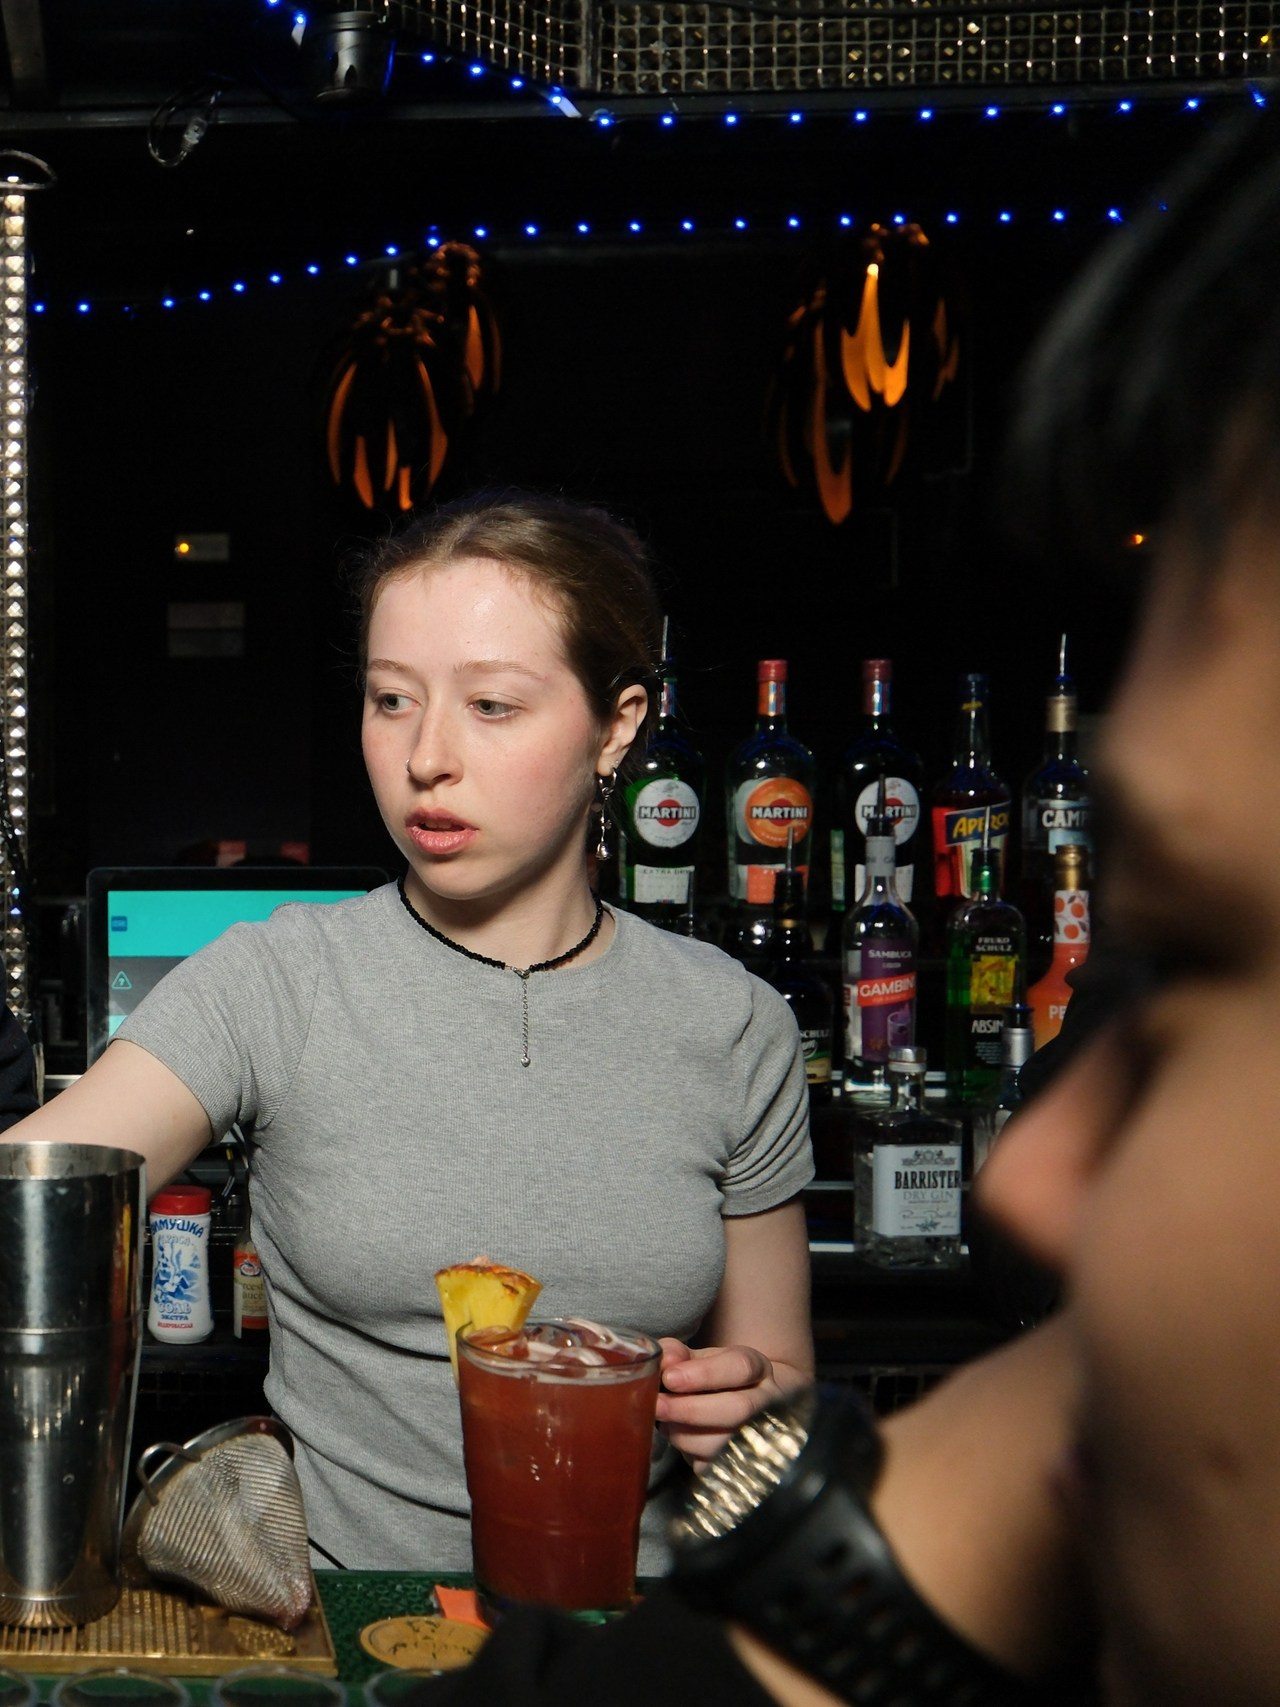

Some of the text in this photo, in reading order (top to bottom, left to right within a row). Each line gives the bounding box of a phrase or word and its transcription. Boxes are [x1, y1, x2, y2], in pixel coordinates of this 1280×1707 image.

[639, 806, 696, 819] MARTINI
[752, 806, 808, 819] MARTINI
[863, 805, 917, 818] MRTINI
[868, 949, 912, 959] SAMBUCA
[895, 1170, 961, 1190] BARRISTER
[903, 1191, 954, 1201] DRY GIN
